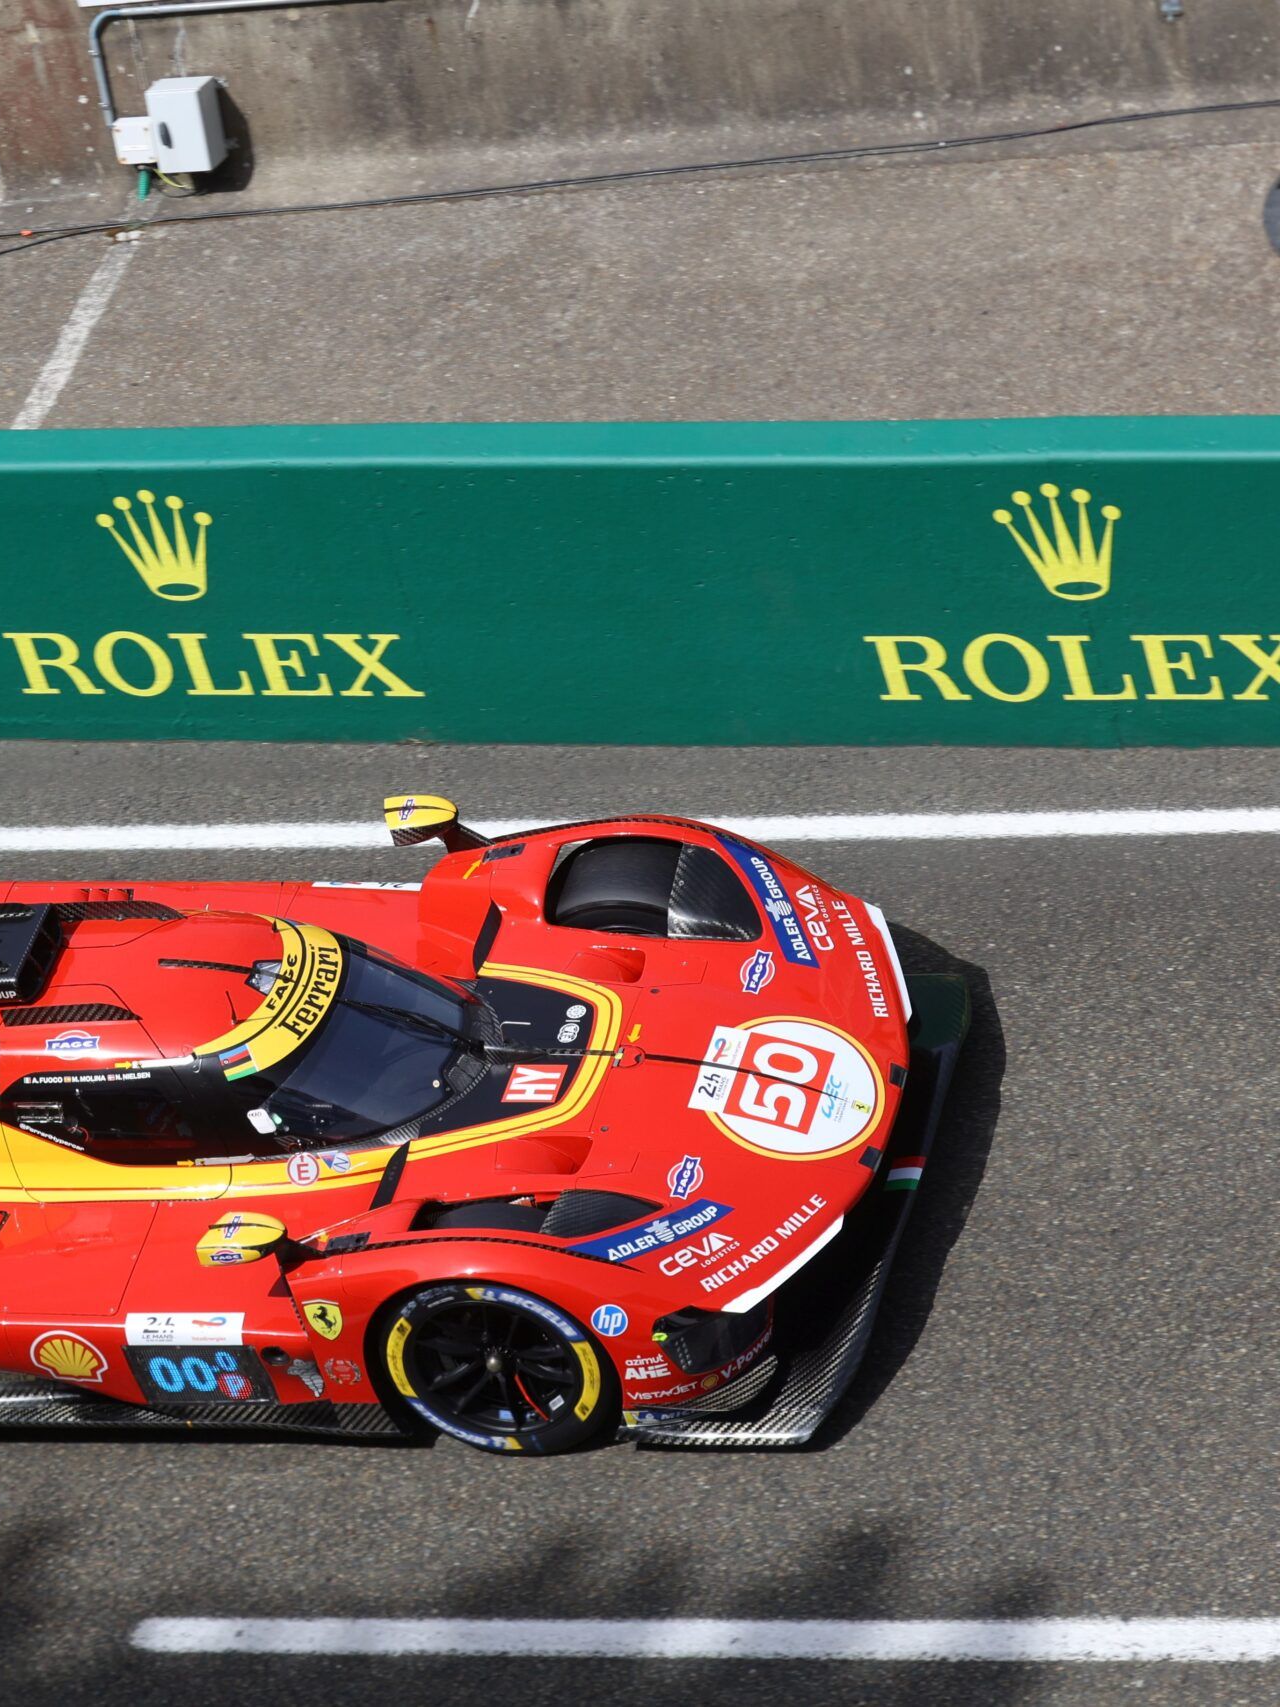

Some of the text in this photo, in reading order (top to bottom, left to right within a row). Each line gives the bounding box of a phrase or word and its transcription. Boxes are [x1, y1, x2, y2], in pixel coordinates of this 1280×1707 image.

[3, 631, 425, 698] ROLEX
[751, 857, 811, 960] ADLER GROUP
[812, 884, 831, 922] LOGISTICS
[266, 954, 297, 1010] FAGE
[832, 900, 889, 1018] RICHARD MILLE
[278, 944, 338, 1041] Ferrari
[123, 1072, 151, 1080] NIELSEN
[506, 1067, 561, 1100] HY
[739, 1042, 818, 1128] 50
[296, 1163, 310, 1181] E
[606, 1205, 718, 1261] ADLER GROUP
[700, 1194, 827, 1292] RICHARD MILLE
[701, 1241, 741, 1268] LOGISTICS
[598, 1308, 622, 1336] hp
[625, 1353, 664, 1367] azimut
[625, 1363, 671, 1380] AHE
